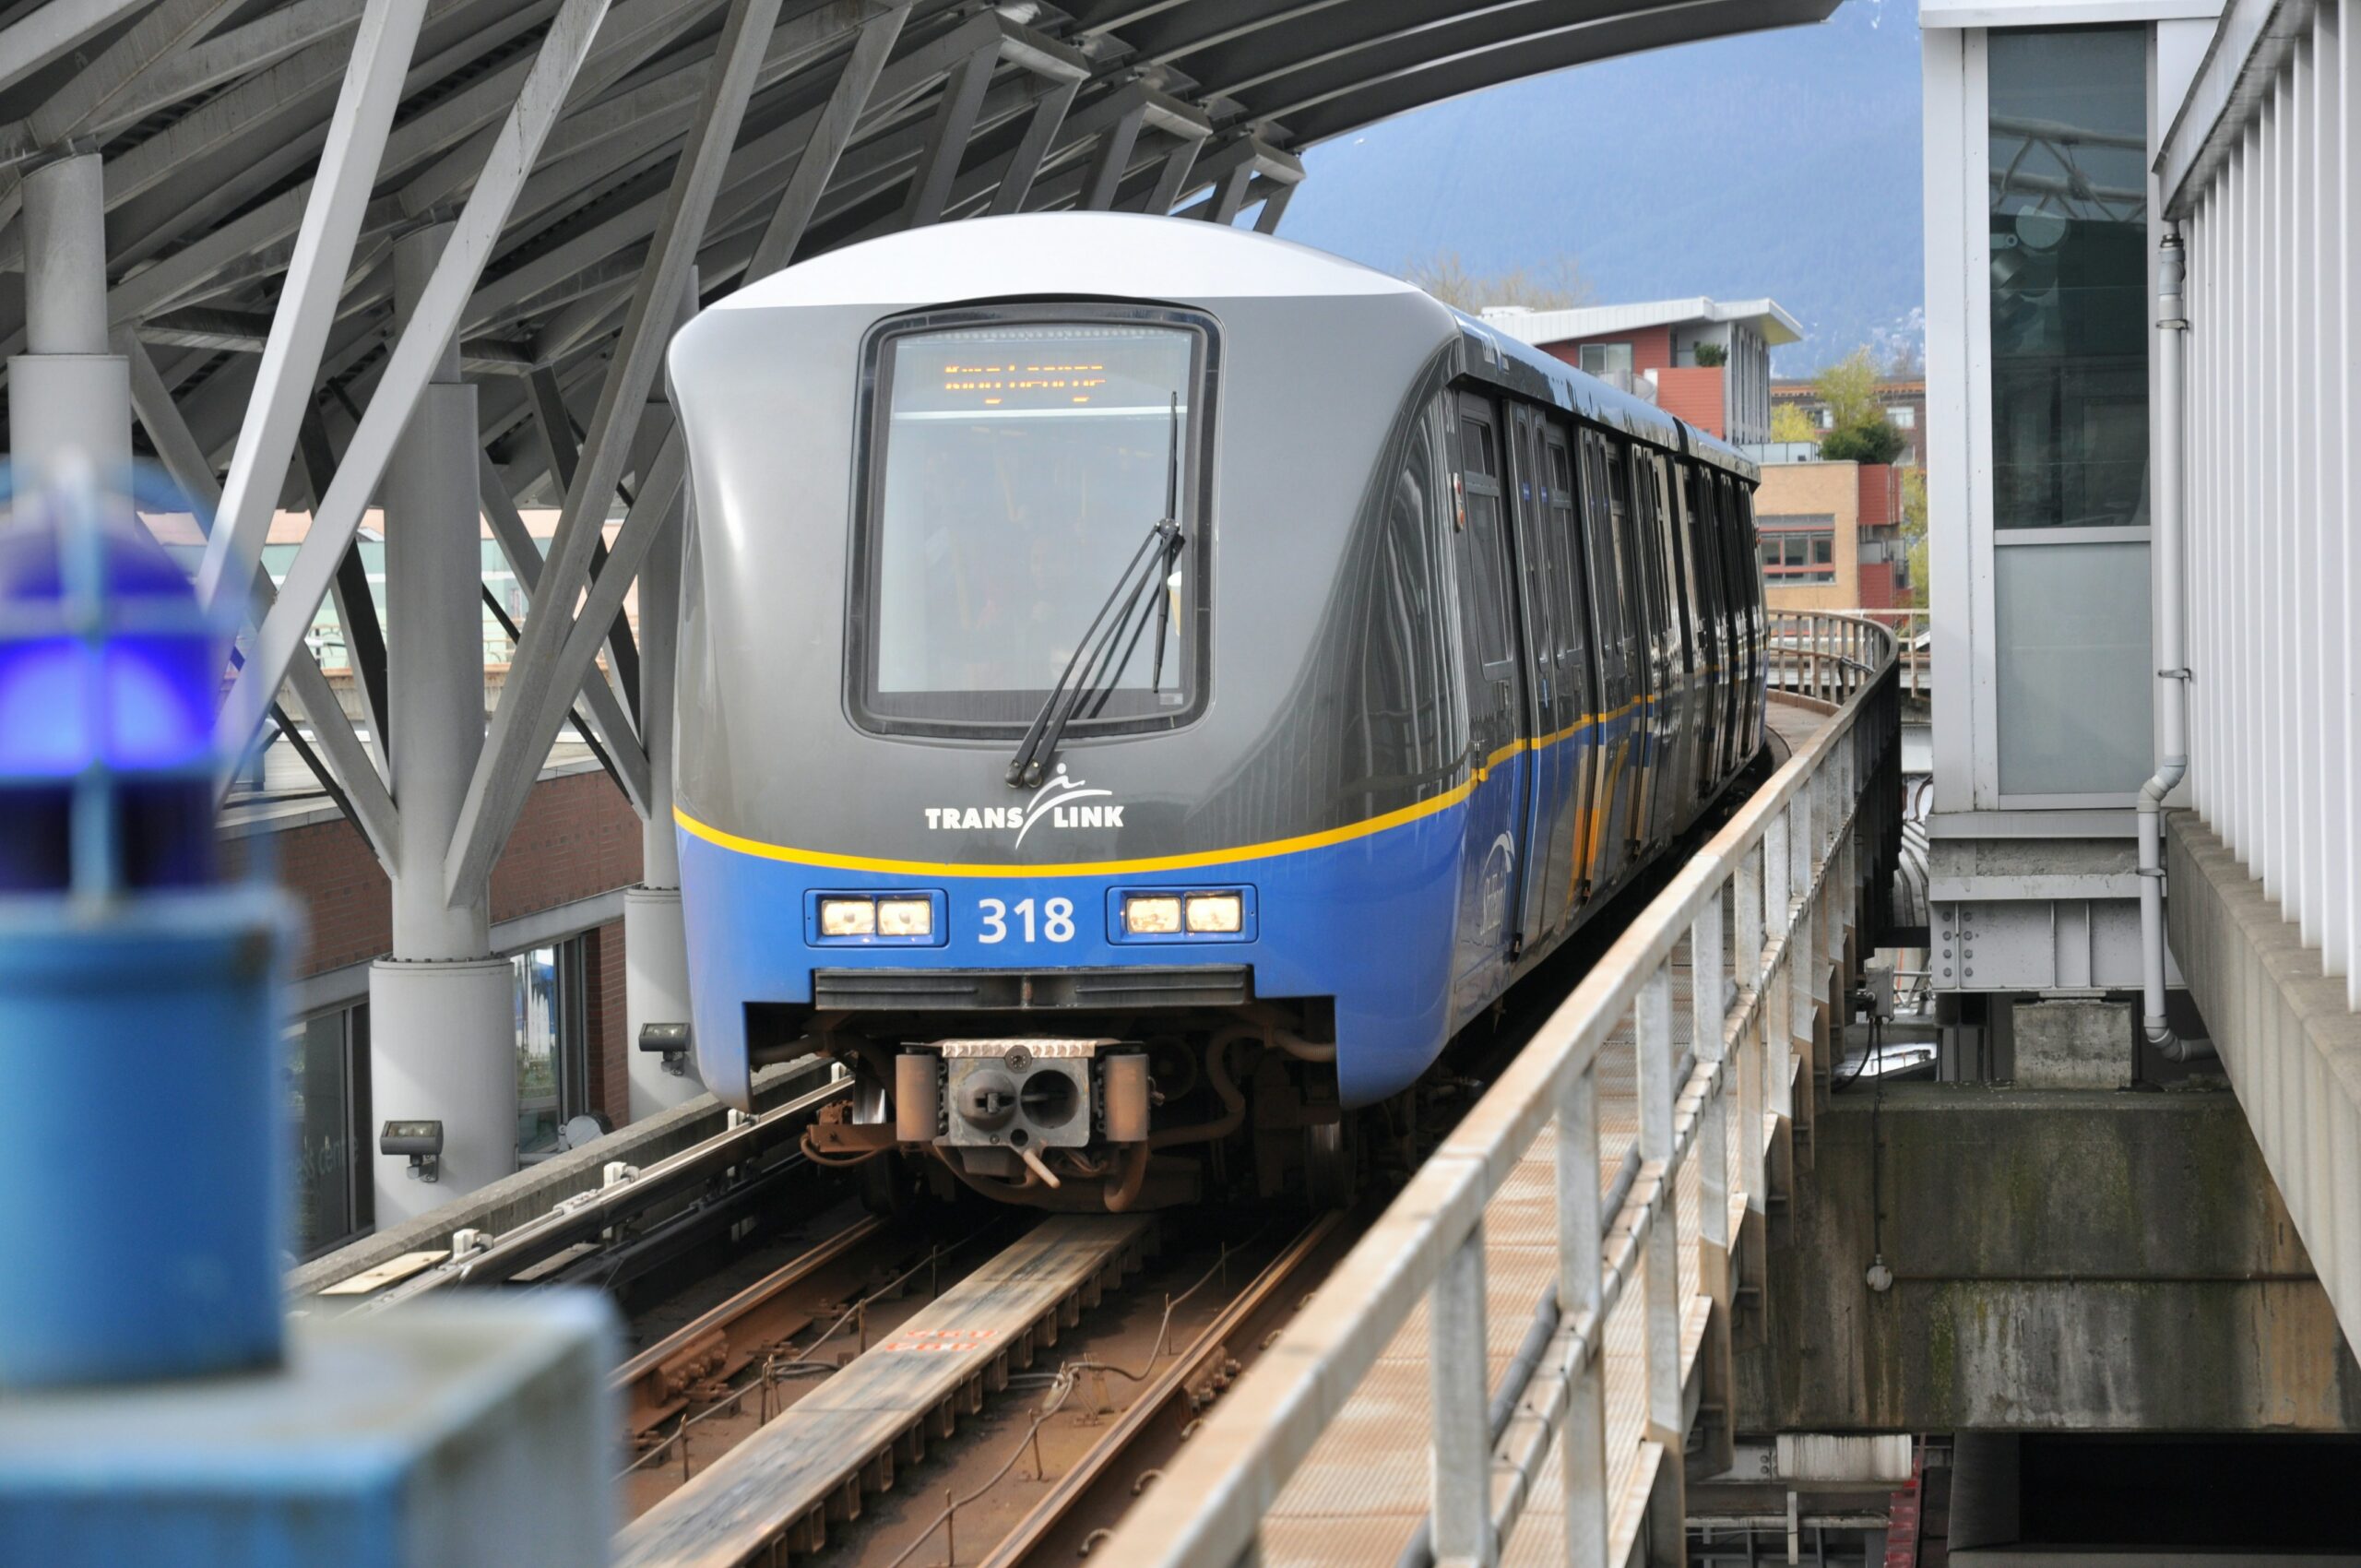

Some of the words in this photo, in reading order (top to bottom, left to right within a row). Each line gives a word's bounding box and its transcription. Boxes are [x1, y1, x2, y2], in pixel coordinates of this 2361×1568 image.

[925, 807, 1024, 829] TRANS
[1054, 805, 1124, 827] LINK
[979, 897, 1075, 944] 318
